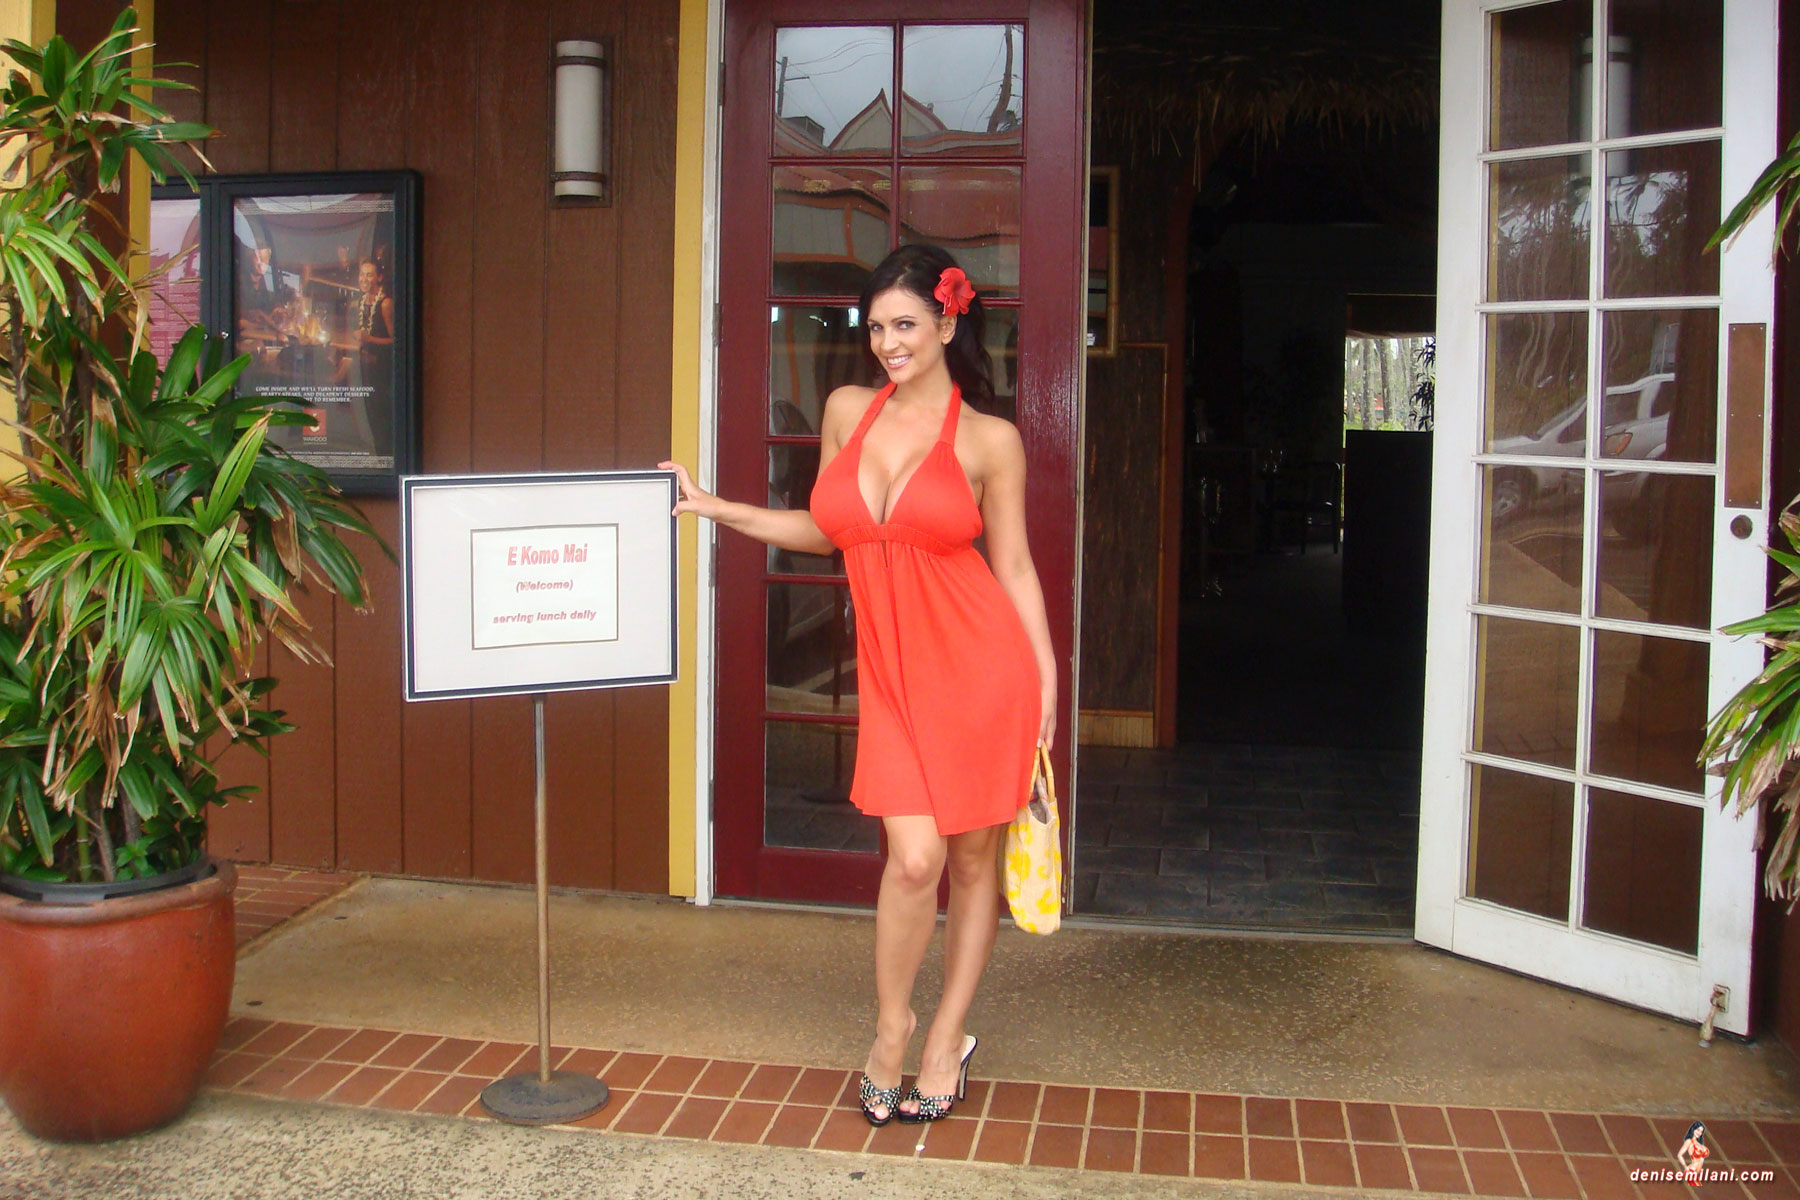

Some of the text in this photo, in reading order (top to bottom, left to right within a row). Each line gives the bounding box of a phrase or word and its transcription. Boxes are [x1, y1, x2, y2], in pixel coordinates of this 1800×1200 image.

[507, 543, 588, 566] E Komo Mai
[516, 579, 574, 593] (Welcome)
[493, 609, 597, 624] serving lunch daily
